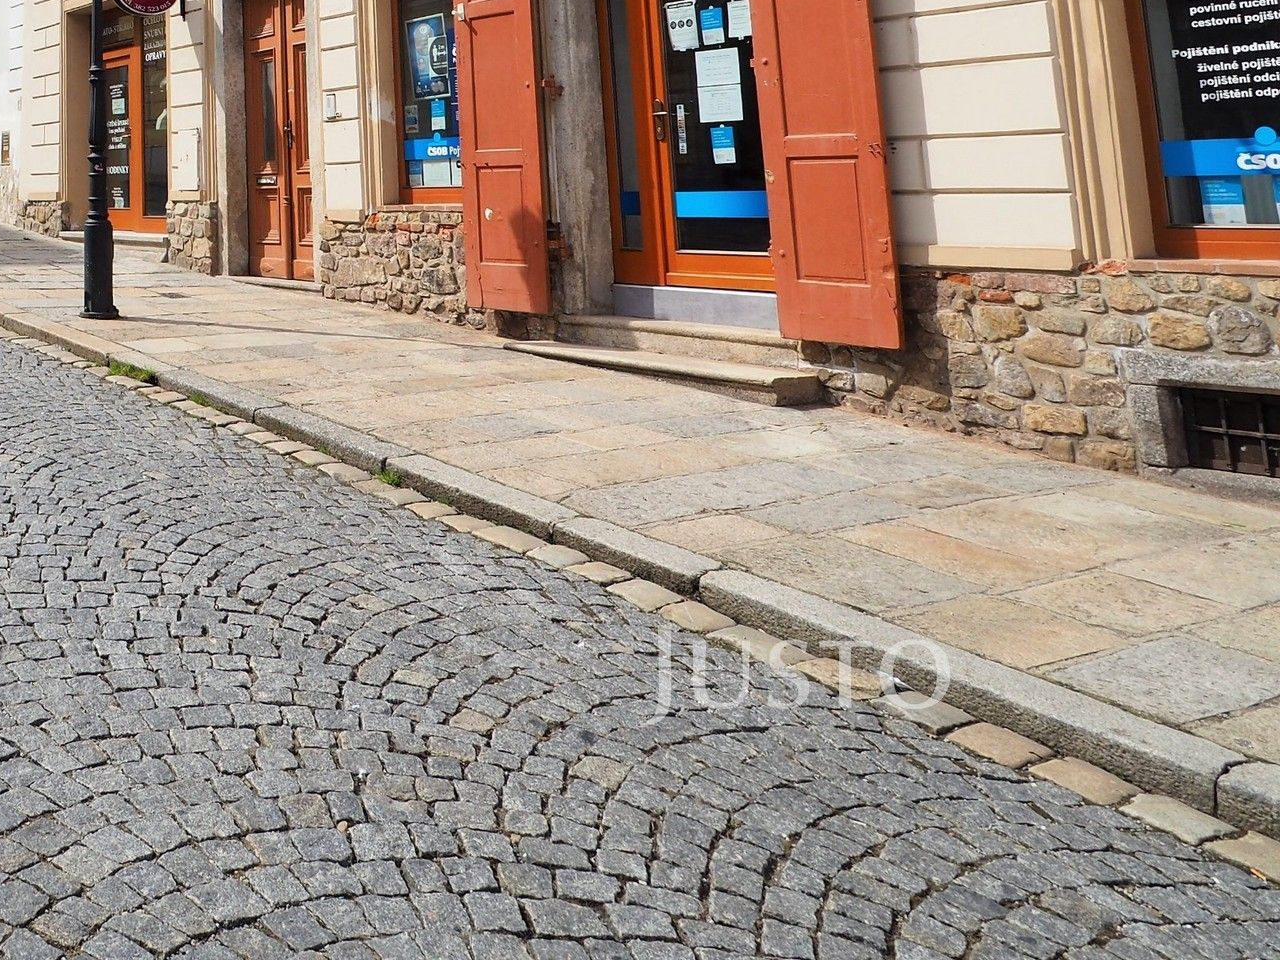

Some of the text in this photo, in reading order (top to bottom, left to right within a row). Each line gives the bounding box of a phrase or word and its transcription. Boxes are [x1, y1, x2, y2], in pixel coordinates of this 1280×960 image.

[1189, 1, 1237, 17] povinné
[1190, 14, 1241, 28] cestovní
[1171, 44, 1229, 59] Pojištění
[1196, 60, 1239, 73] živelné
[1199, 73, 1250, 88] pojištění
[1201, 86, 1280, 102] pojištění odp
